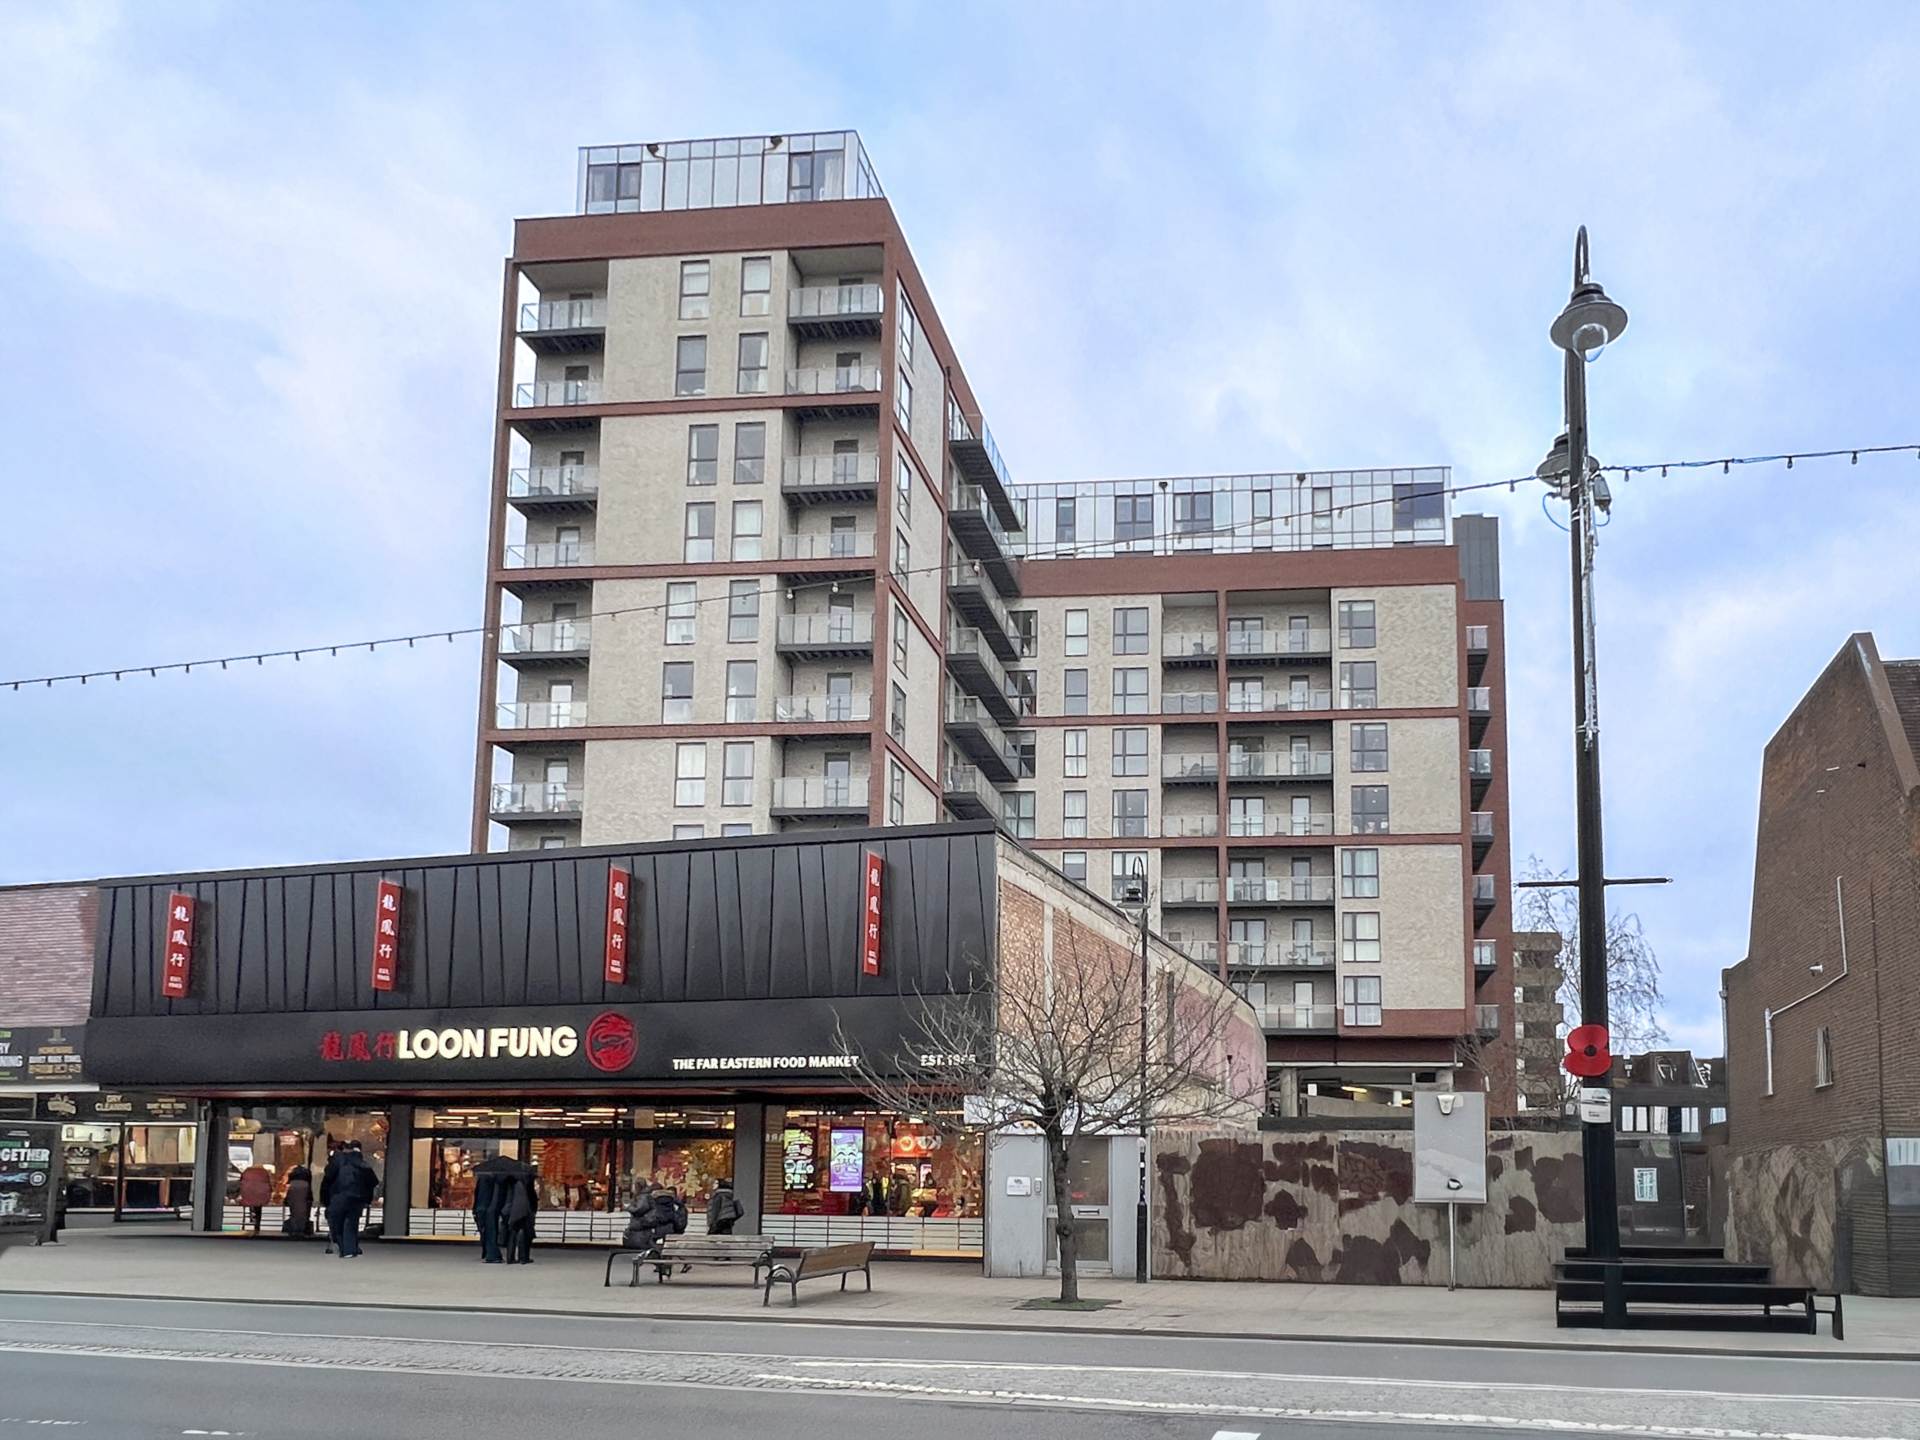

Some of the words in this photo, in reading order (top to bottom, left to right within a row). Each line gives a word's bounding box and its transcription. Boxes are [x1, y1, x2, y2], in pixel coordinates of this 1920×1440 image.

[398, 1028, 486, 1060] LOON
[489, 1025, 579, 1058] FUNG
[672, 1058, 696, 1071] THE
[696, 1057, 719, 1070] FAR
[720, 1056, 772, 1069] EASTERN
[773, 1056, 807, 1069] FOOD
[808, 1055, 860, 1068] MARKET
[0, 1148, 50, 1162] GETHER
